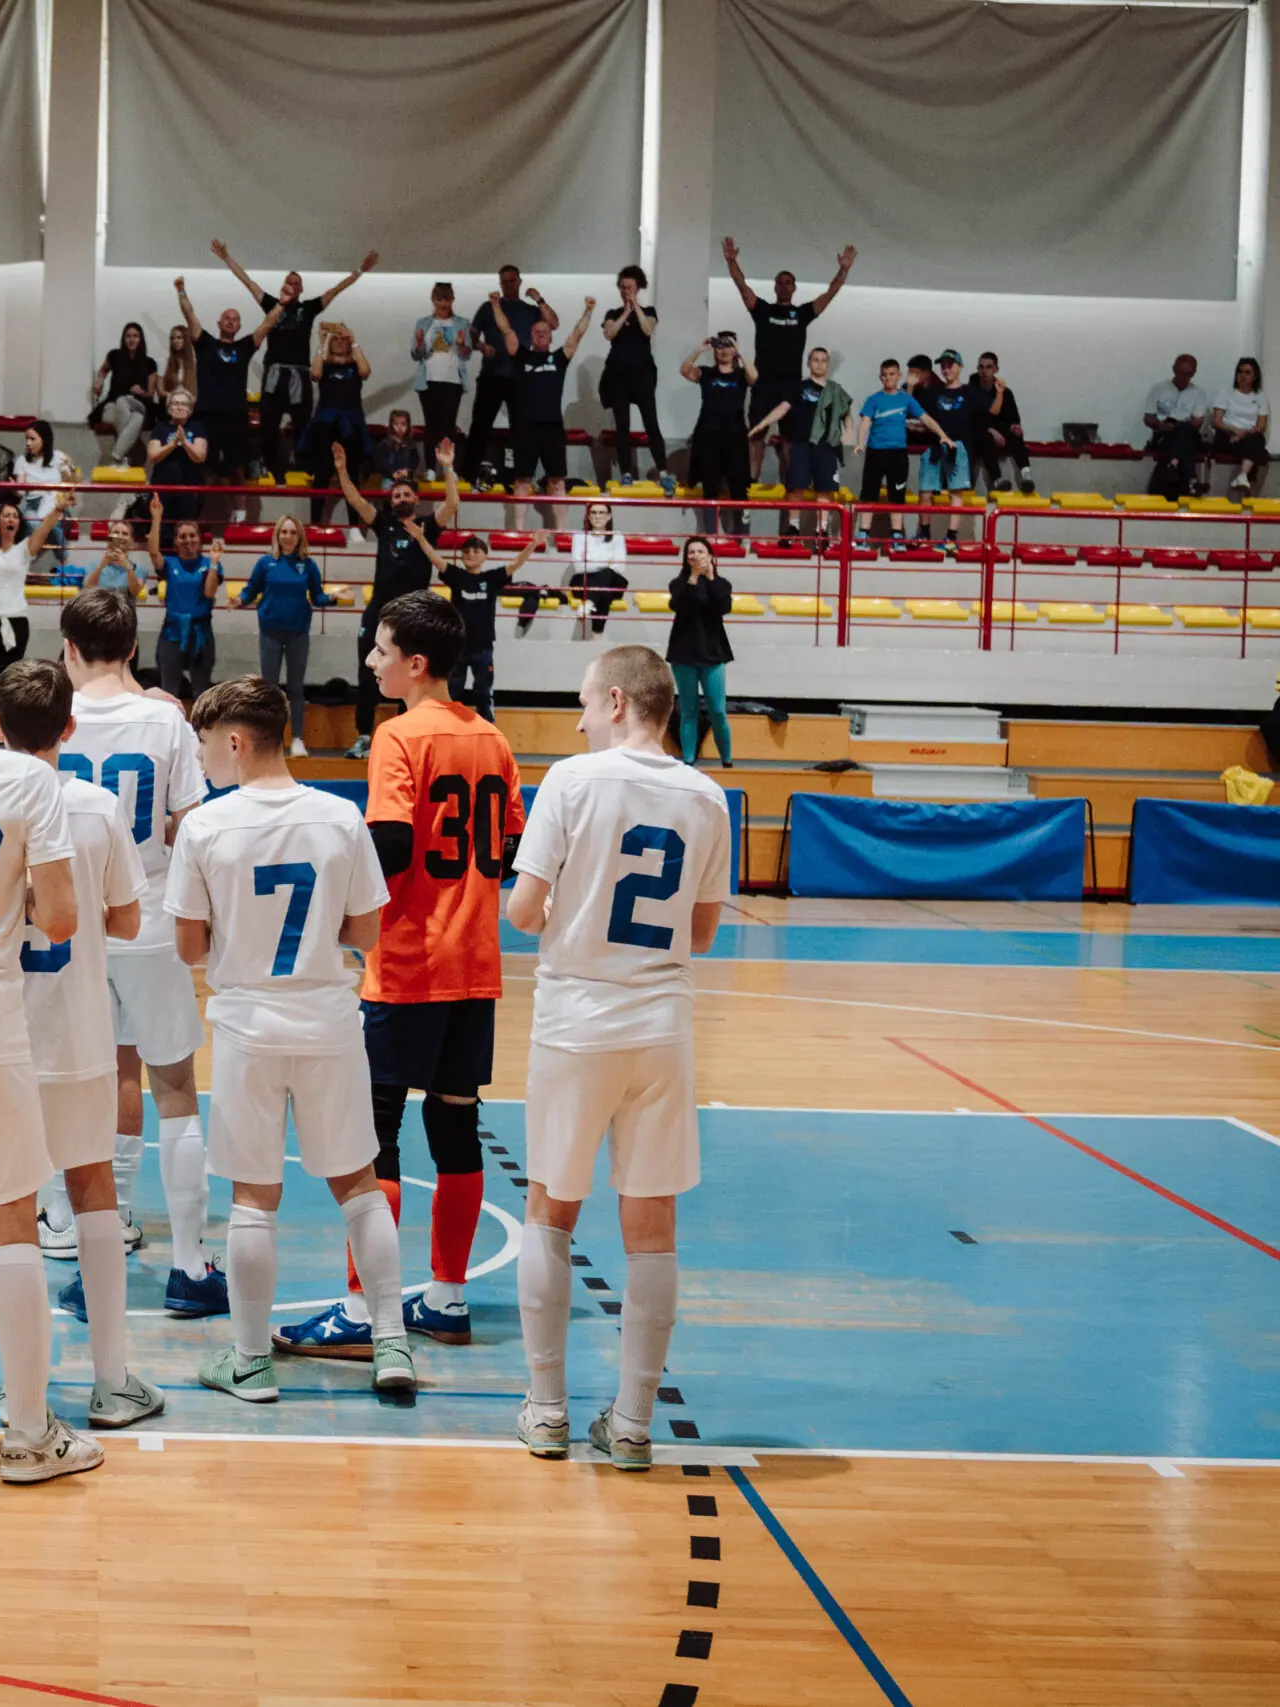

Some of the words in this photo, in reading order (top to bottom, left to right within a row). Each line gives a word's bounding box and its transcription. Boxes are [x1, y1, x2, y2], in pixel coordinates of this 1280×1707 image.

[425, 774, 508, 879] 30
[253, 862, 317, 977] 7
[607, 824, 686, 950] 2
